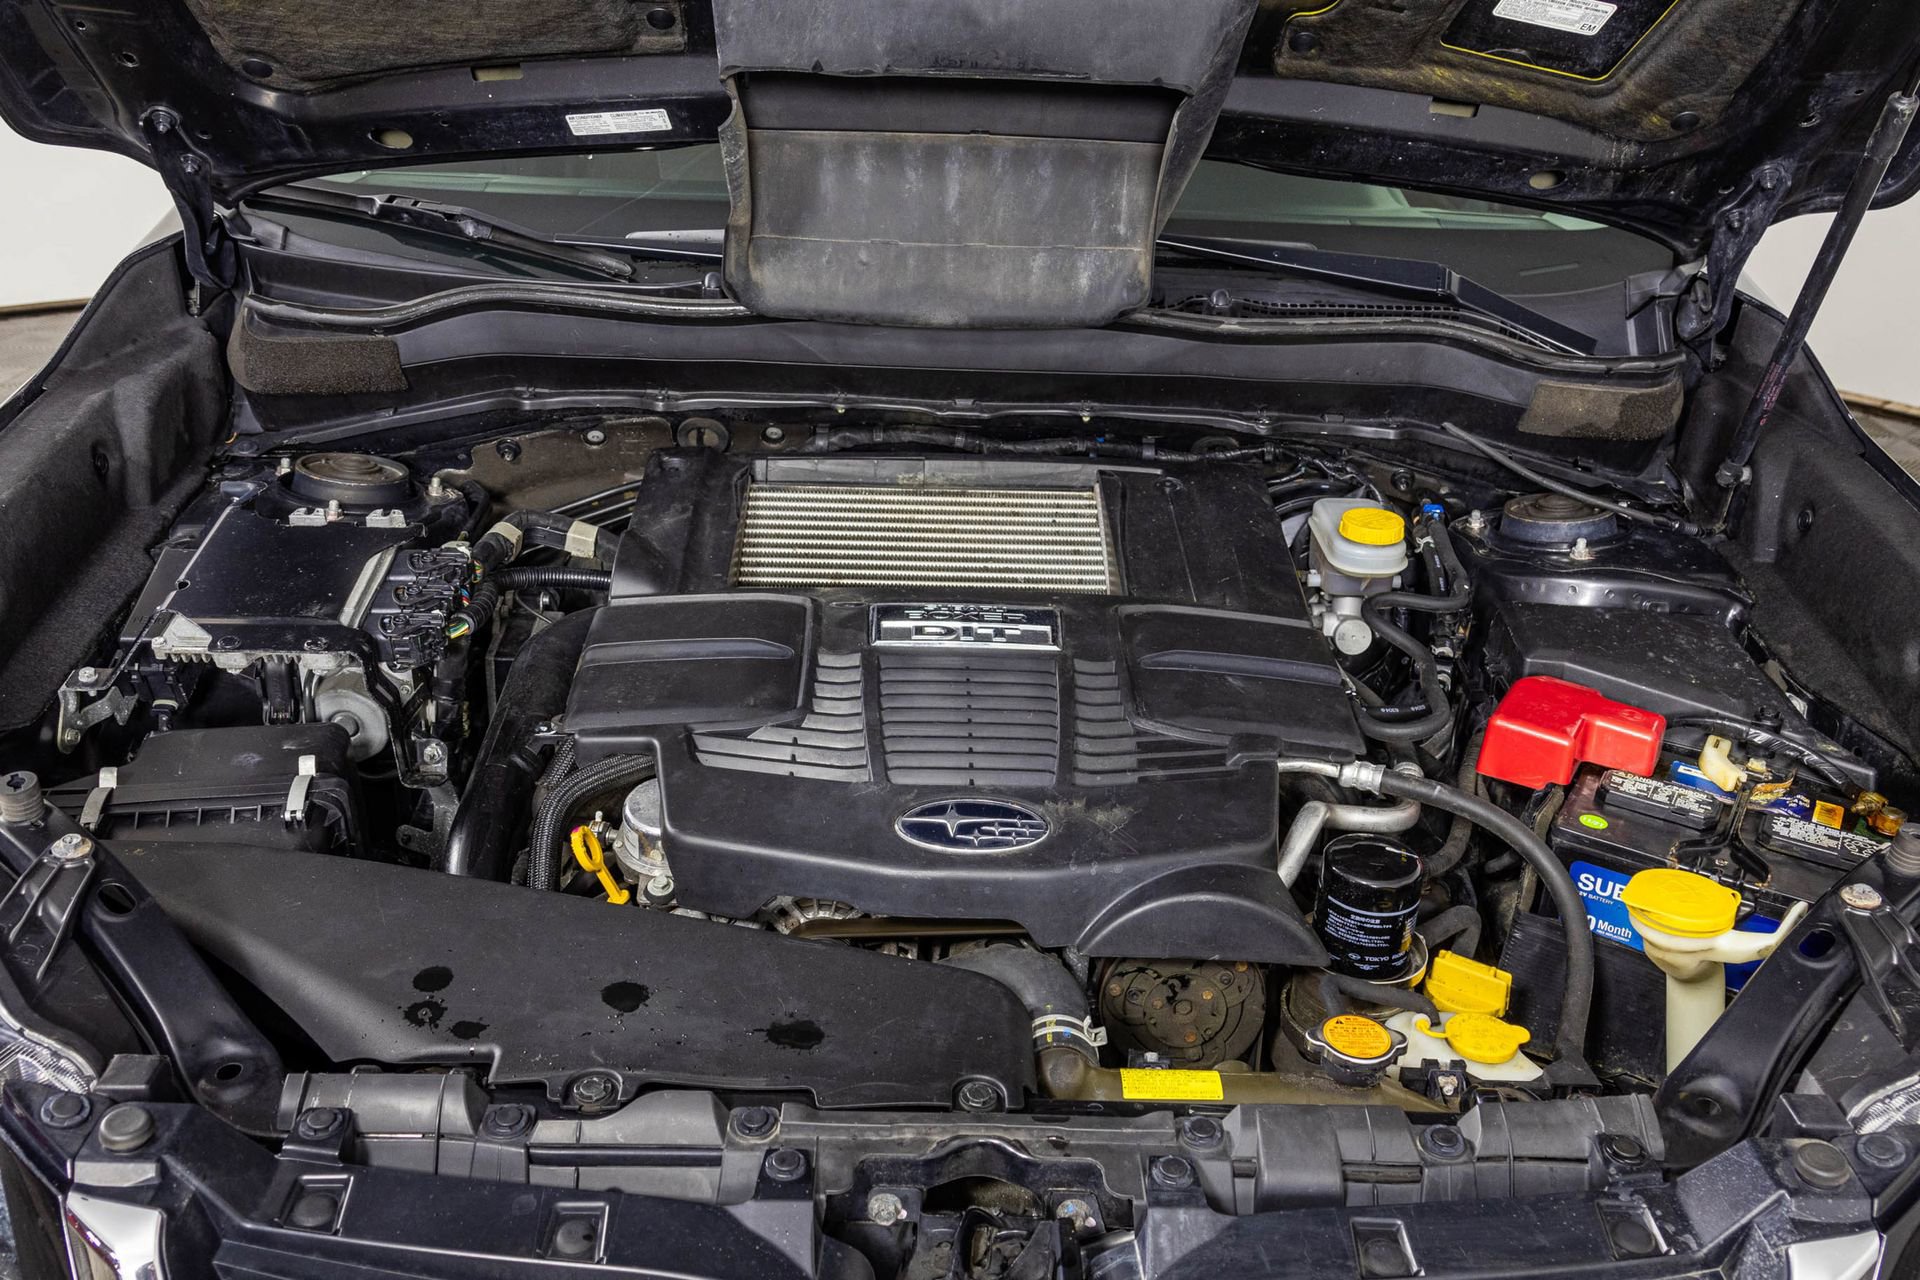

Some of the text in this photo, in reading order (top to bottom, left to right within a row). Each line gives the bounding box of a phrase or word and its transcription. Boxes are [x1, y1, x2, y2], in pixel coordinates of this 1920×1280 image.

[1579, 23, 1597, 32] EM
[904, 610, 1028, 623] BOXER
[911, 624, 1022, 642] DIT
[1630, 773, 1663, 787] DANGER
[1672, 785, 1708, 799] POISON
[1588, 893, 1614, 905] BATTERY
[1597, 919, 1632, 939] Month
